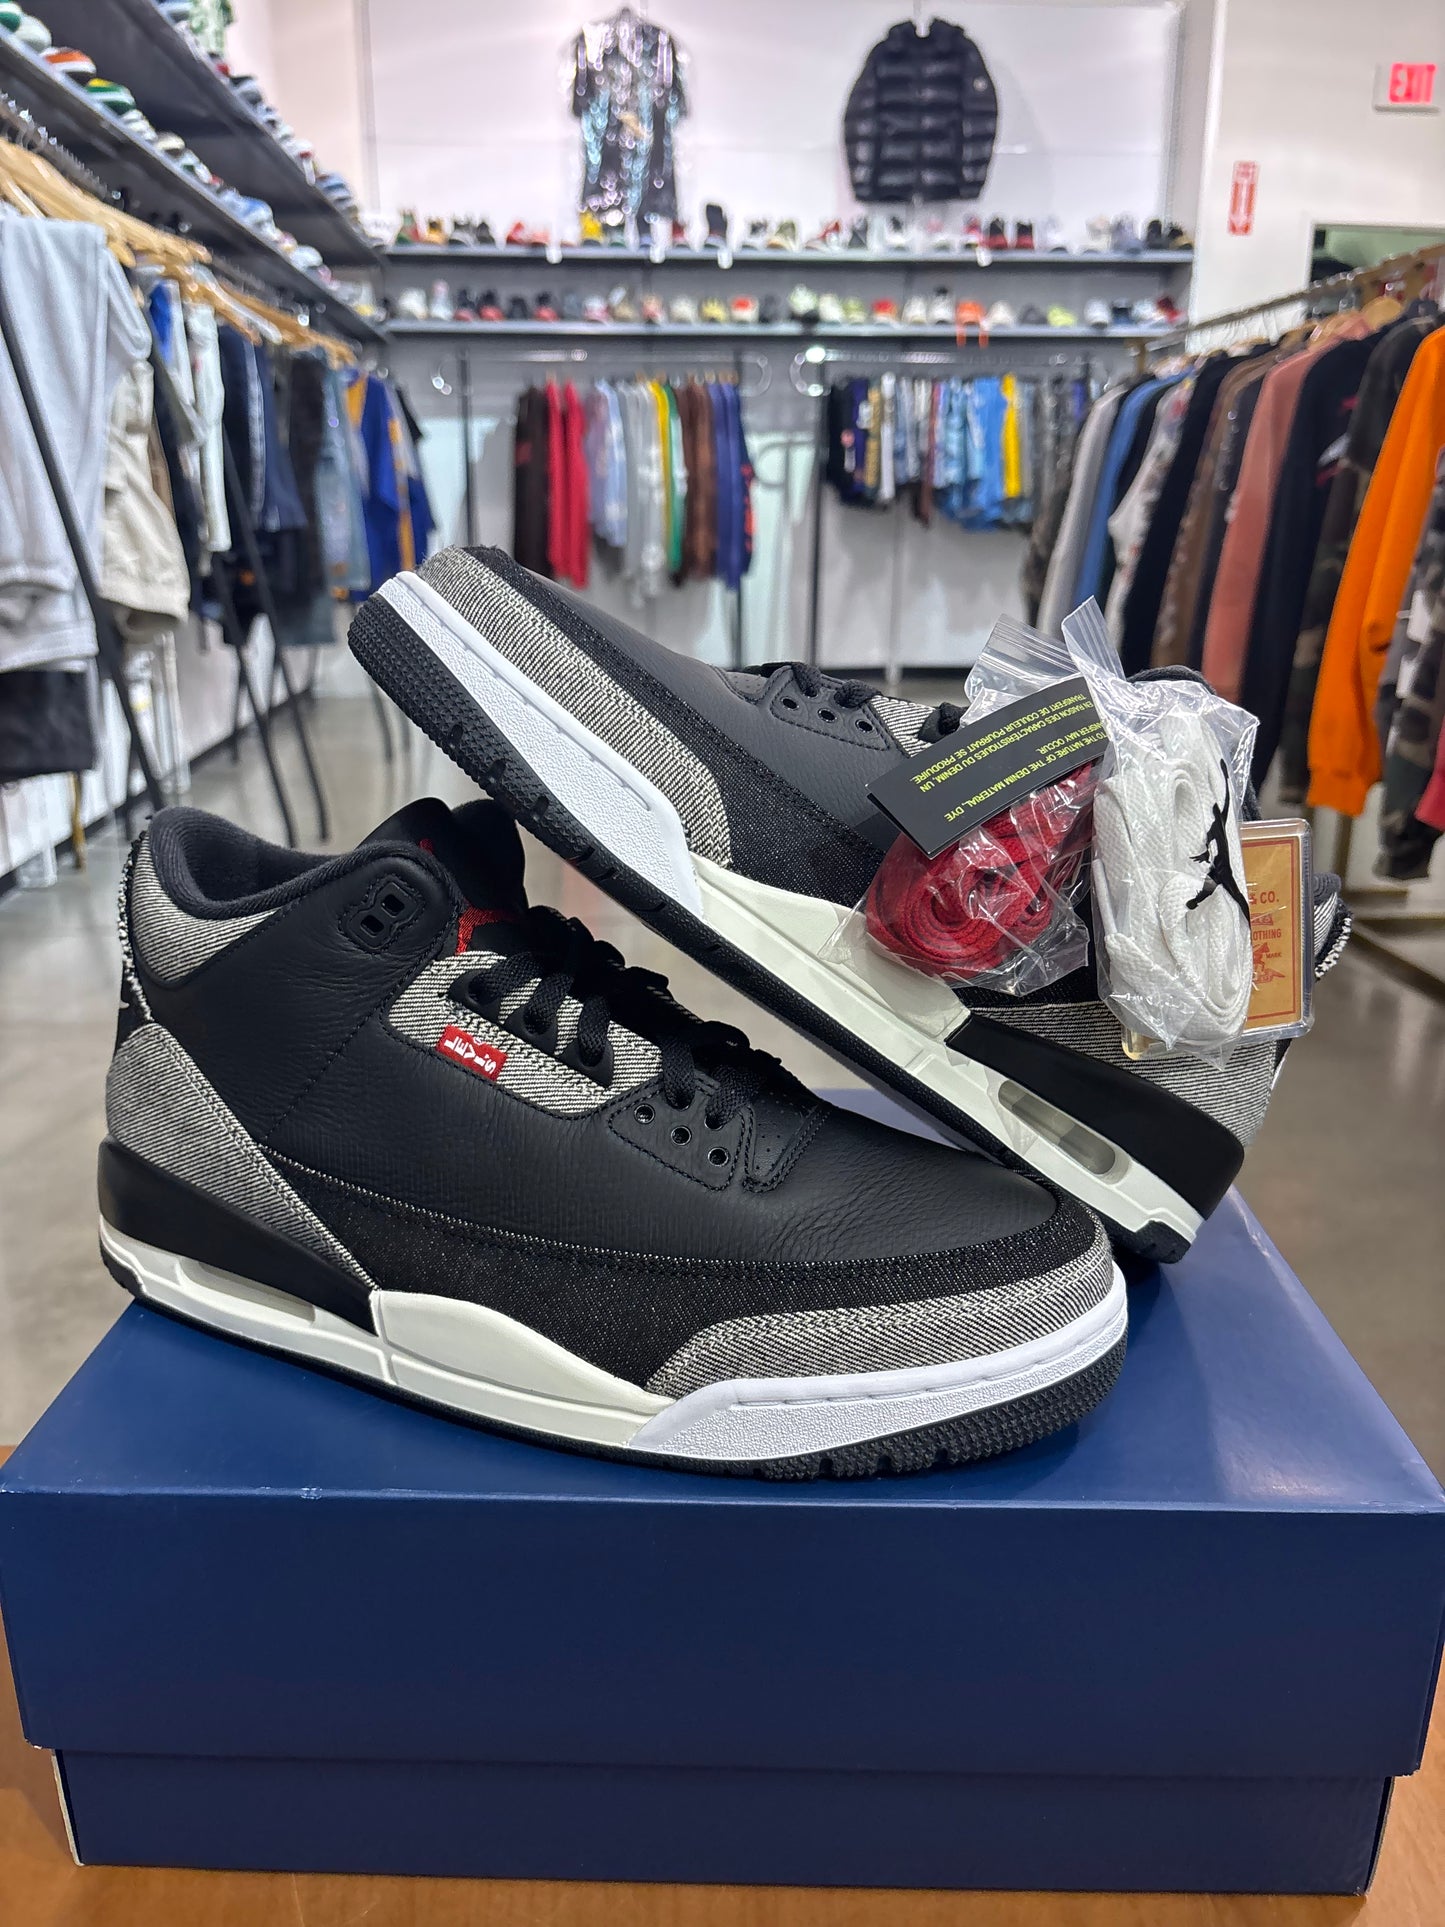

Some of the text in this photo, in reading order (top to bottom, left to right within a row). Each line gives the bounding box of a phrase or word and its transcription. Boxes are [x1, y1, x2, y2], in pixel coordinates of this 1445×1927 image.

[1390, 63, 1435, 103] EXIT
[911, 694, 1086, 784] TRANSFERT DE COULEUR POURRAIT SE PRODUIRE.
[1064, 731, 1081, 742] MAY
[1082, 735, 1098, 745] THE
[920, 700, 1094, 792] EN RAISON DES CARACTÉRISTIQUES DU DENIM, UN
[1055, 740, 1085, 758] NATURE
[1028, 760, 1045, 772] THE
[1045, 754, 1057, 764] OF
[1003, 767, 1031, 785] DENIM
[945, 806, 964, 822] DYE
[1260, 891, 1279, 904] CO.
[1252, 928, 1281, 940] OTHING
